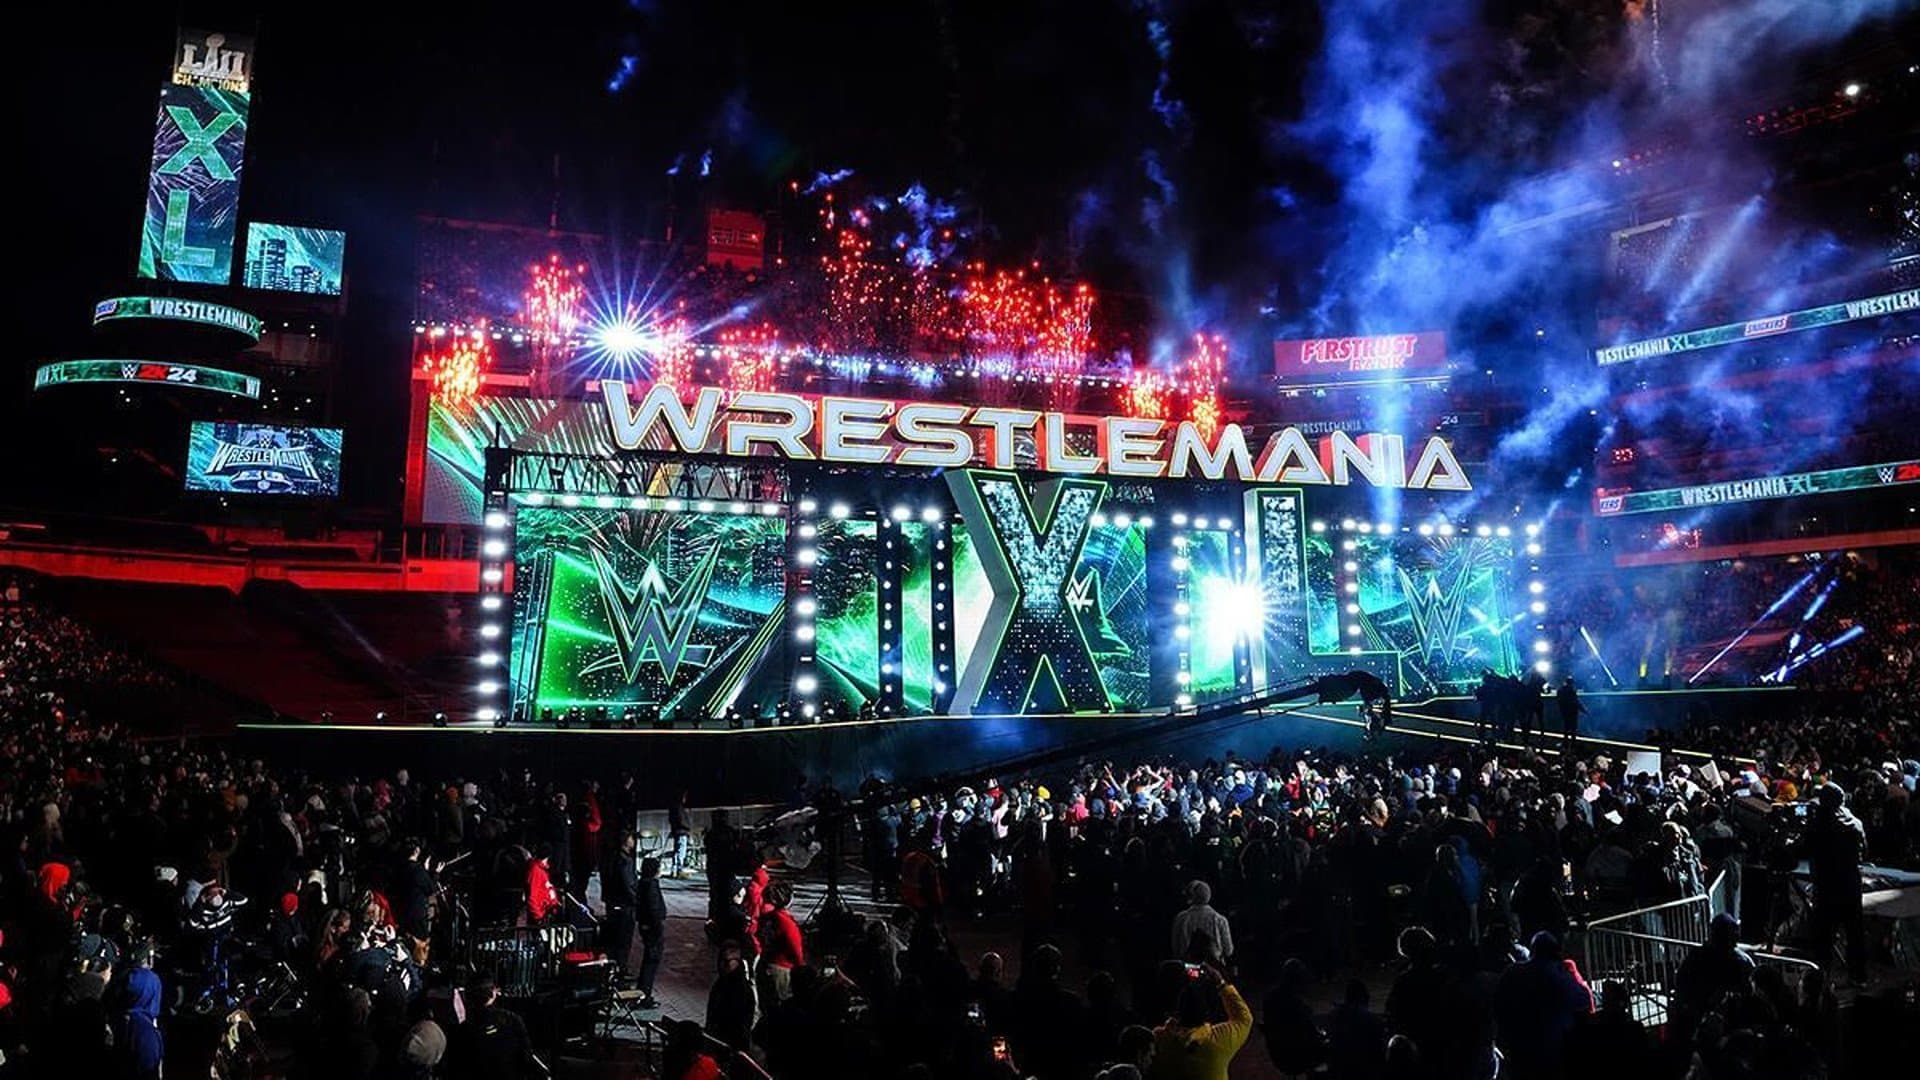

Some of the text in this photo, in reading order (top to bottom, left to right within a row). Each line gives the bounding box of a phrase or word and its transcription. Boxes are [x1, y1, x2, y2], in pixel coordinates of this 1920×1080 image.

[150, 300, 247, 331] WRESTLEMANIA
[1671, 335, 1695, 352] XL
[50, 364, 67, 382] XL
[1351, 357, 1405, 371] BANK
[601, 380, 1473, 492] WRESTLEMANIA
[1681, 478, 1788, 505] WRESTLEMANIA
[1789, 474, 1819, 494] XL
